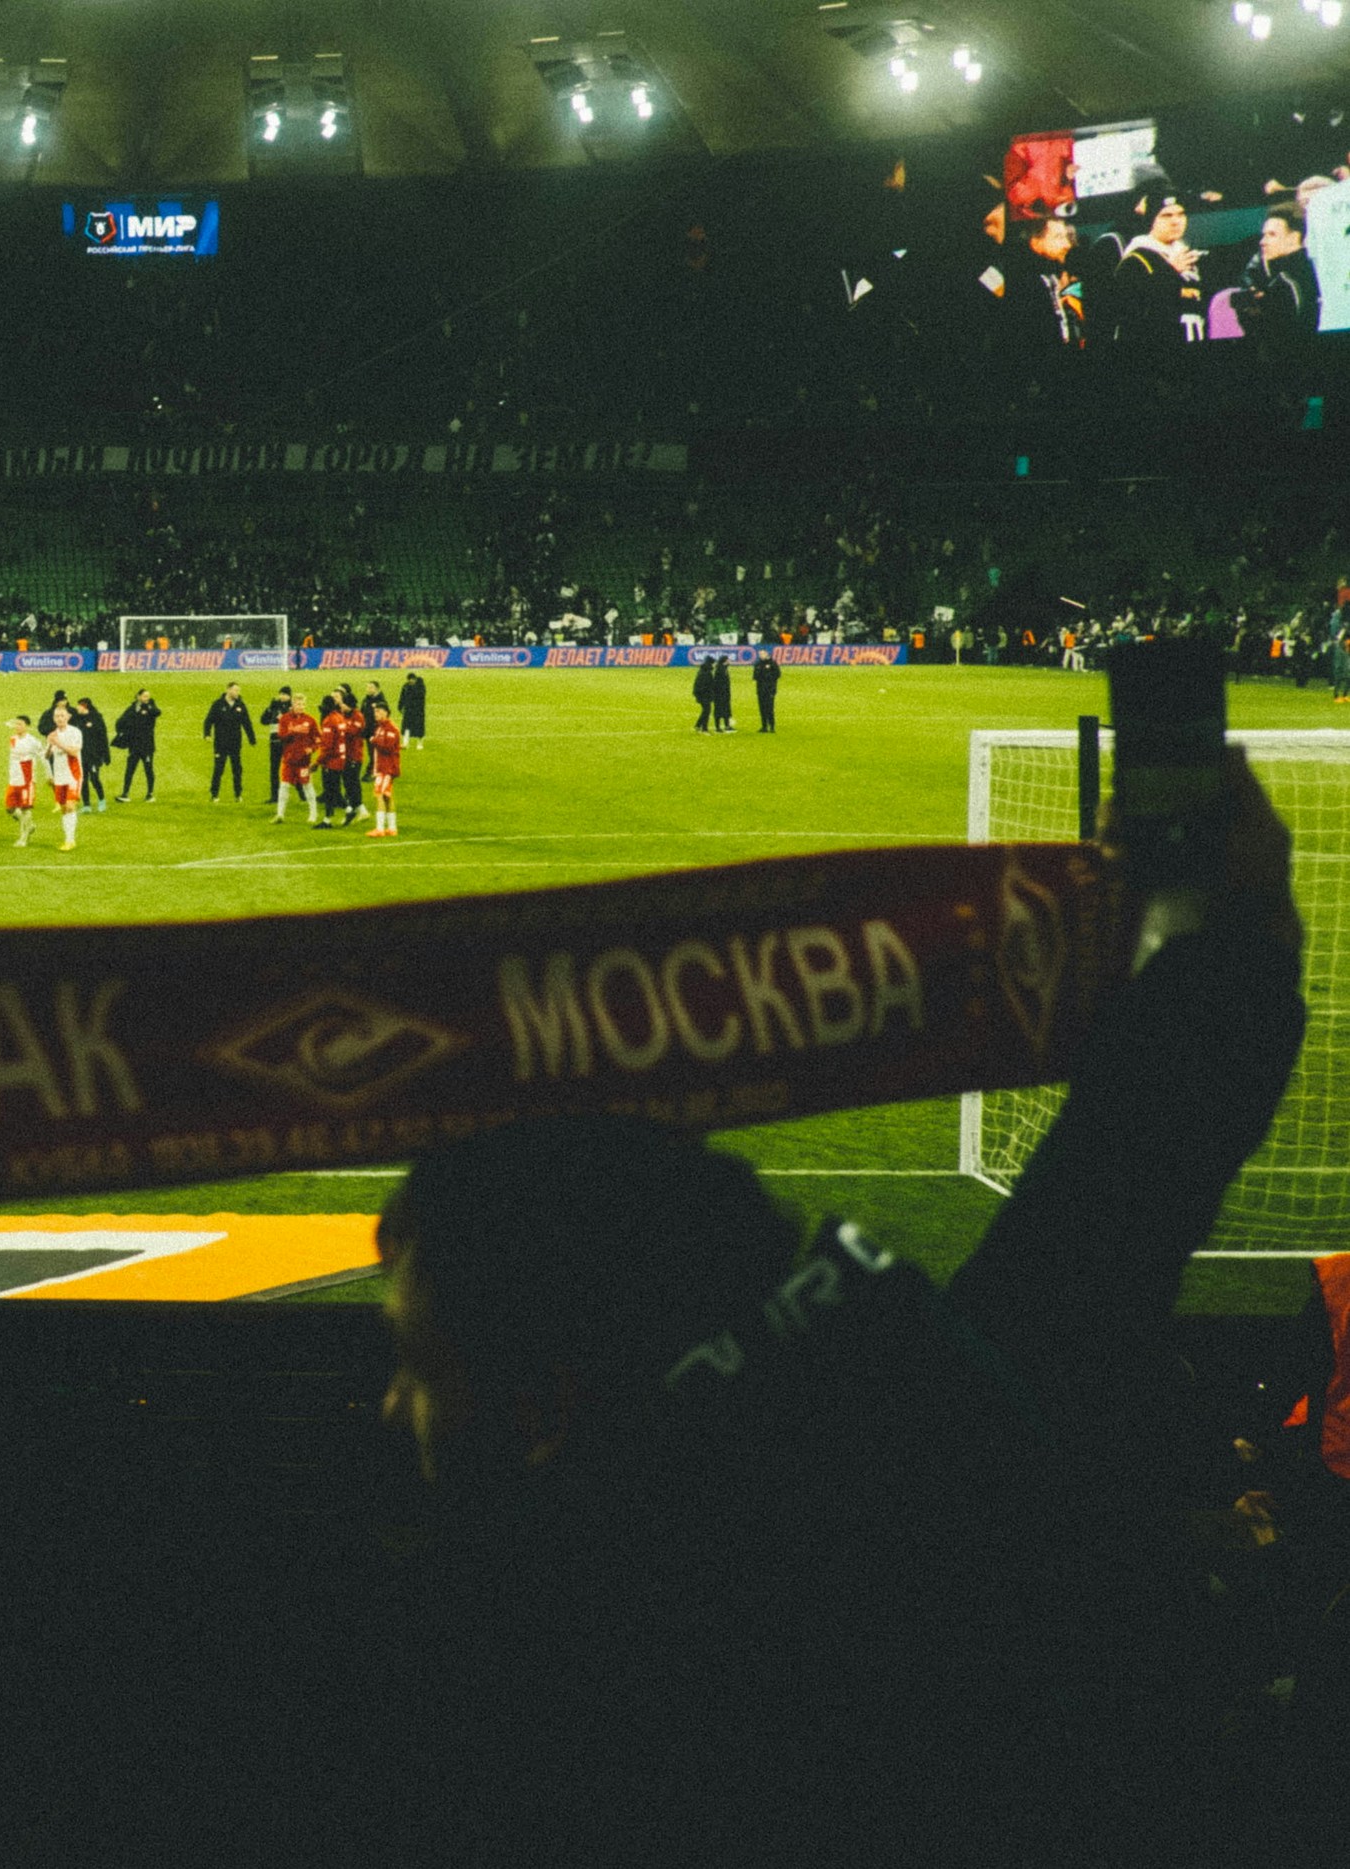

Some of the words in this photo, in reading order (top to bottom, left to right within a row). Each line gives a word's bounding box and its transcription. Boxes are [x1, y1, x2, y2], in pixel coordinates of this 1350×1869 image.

[127, 205, 197, 237] МИР
[22, 655, 64, 668] Winline
[156, 652, 226, 671] РАЗНИЦУ
[320, 649, 379, 669] ДЕЛАЕТ
[379, 649, 450, 668] РАЗНИЦУ
[469, 651, 511, 664] Winline
[544, 648, 604, 667] ДЕЛАЕТ
[605, 647, 675, 666] РАЗНИЦУ
[772, 645, 831, 665] ДЕЛАЕТ
[831, 645, 901, 665] РАЗНИЦУ
[495, 920, 925, 1082] МОСКВА
